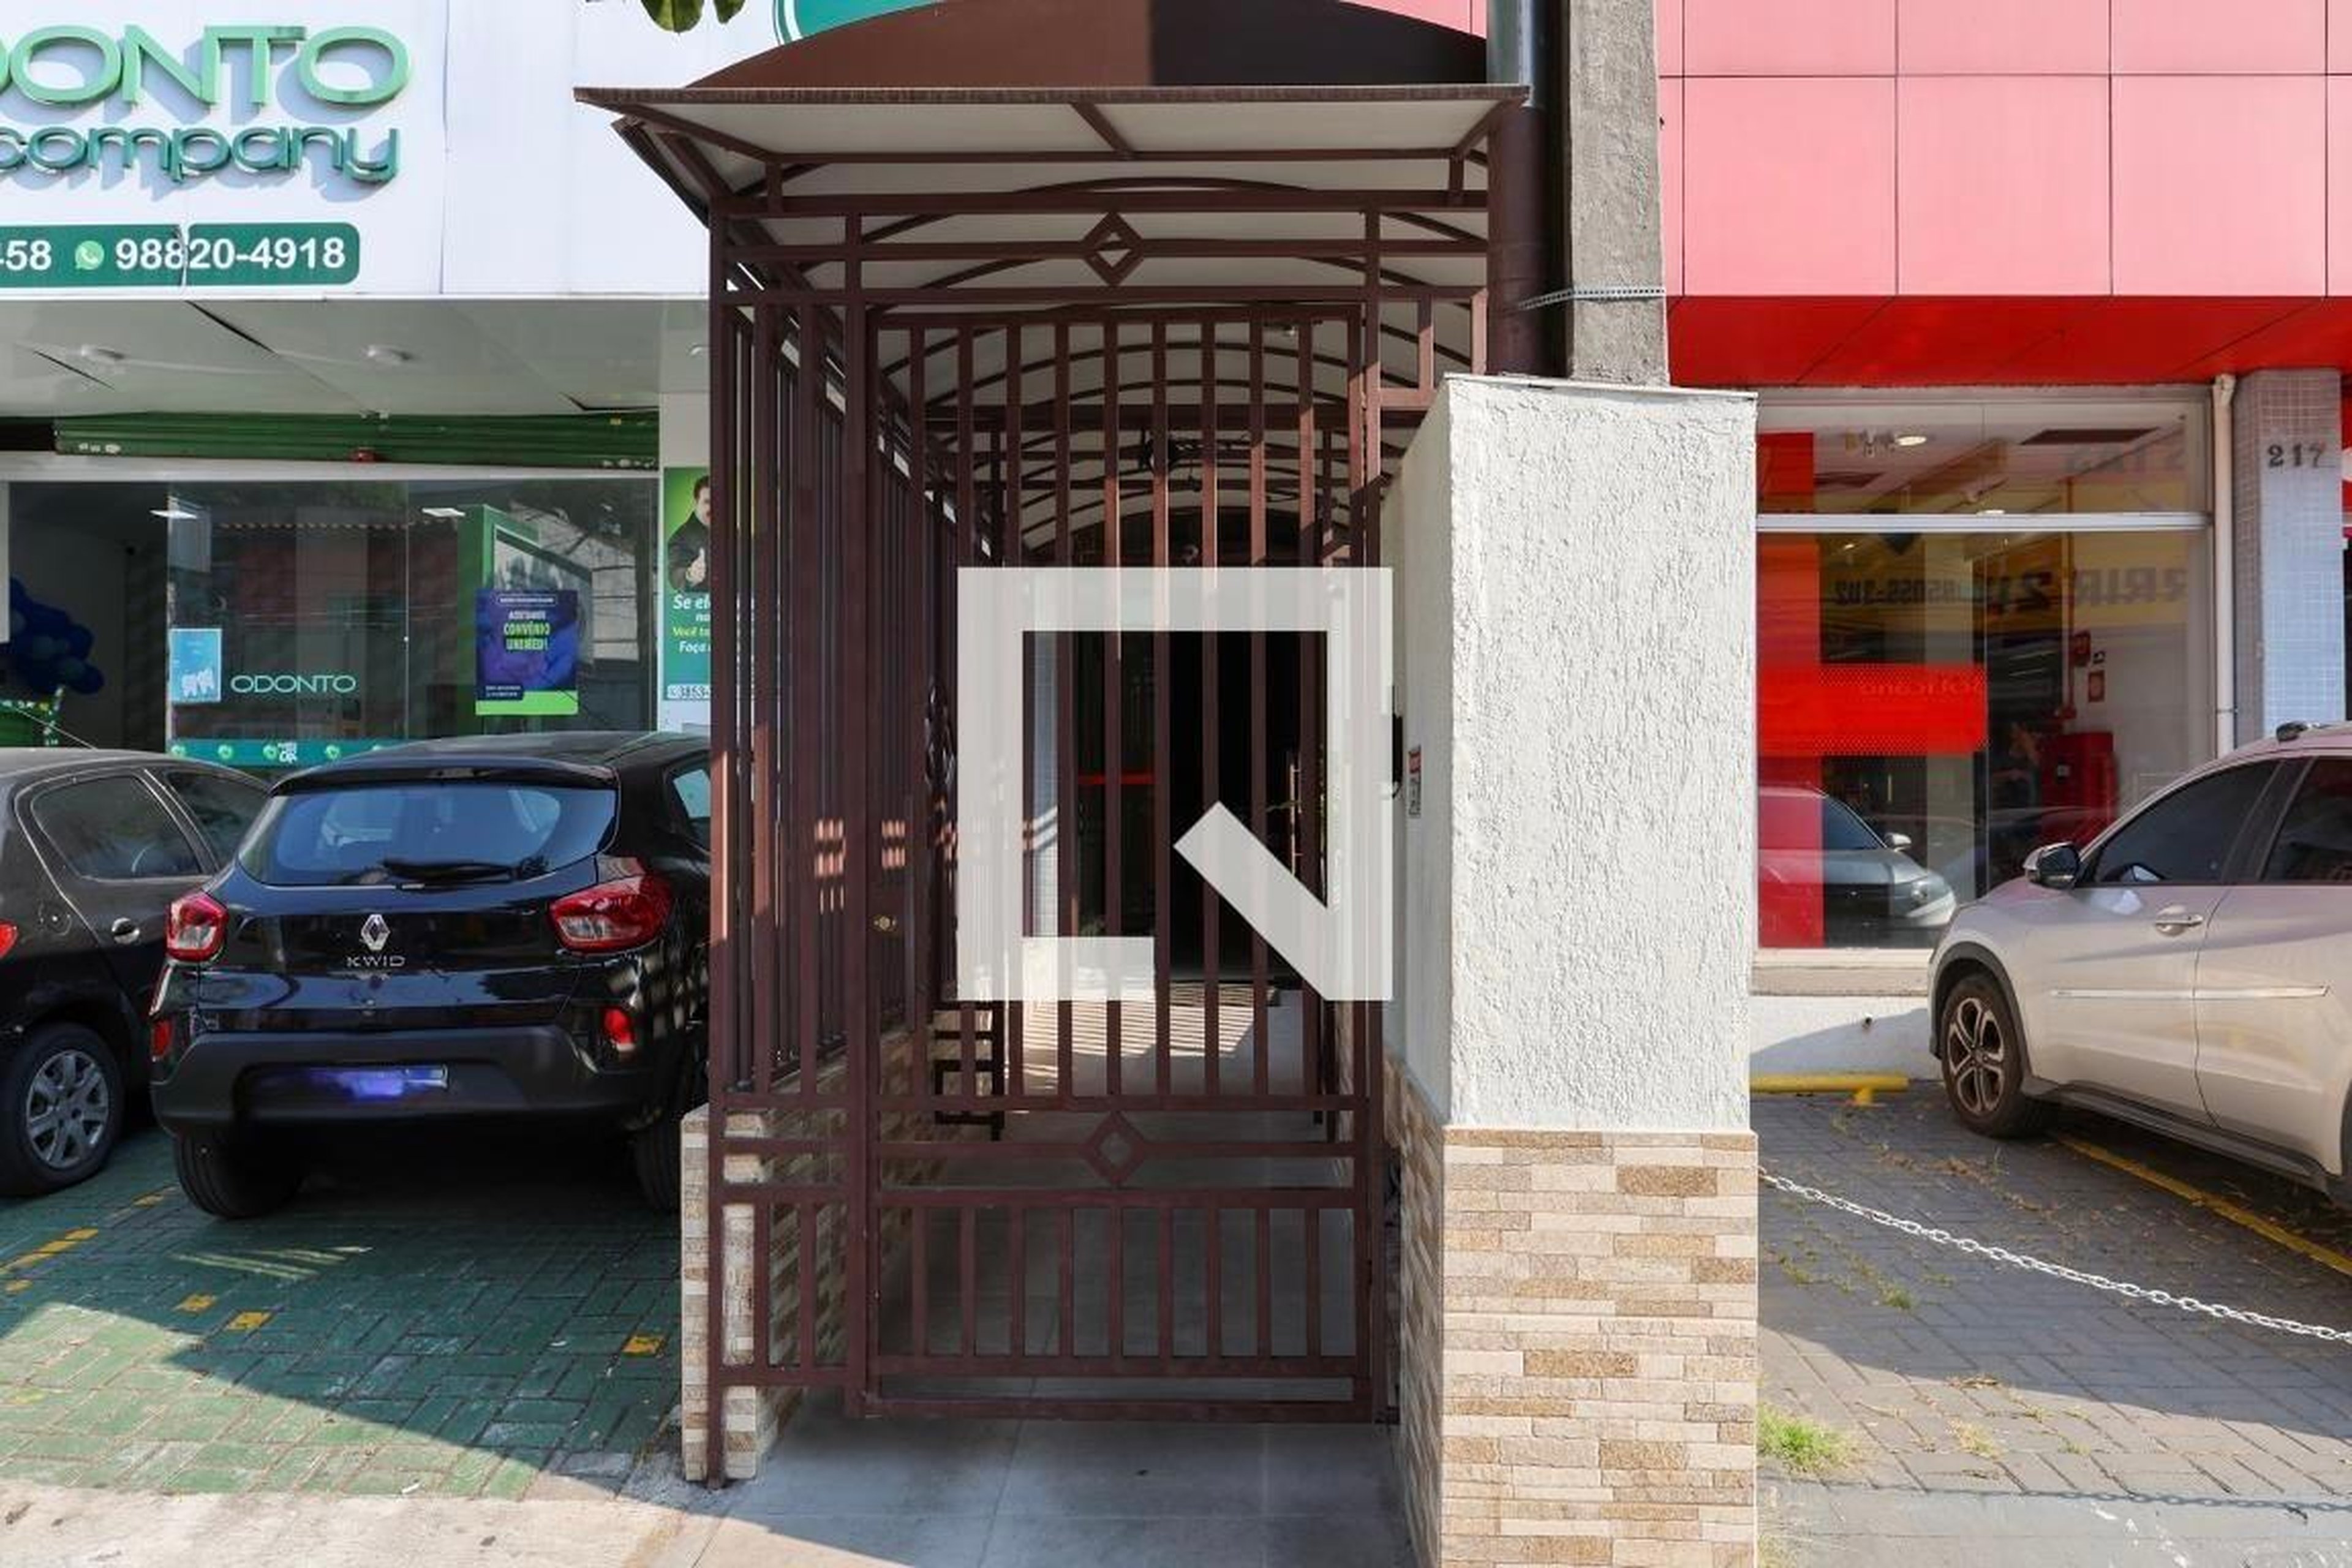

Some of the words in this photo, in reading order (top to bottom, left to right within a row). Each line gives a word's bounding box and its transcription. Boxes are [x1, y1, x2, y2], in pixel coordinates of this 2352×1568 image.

[0, 25, 410, 107] ONTO
[0, 239, 53, 271] 58
[115, 236, 346, 270] 98820-4918
[2267, 442, 2326, 468] 217
[673, 594, 692, 609] Se
[230, 674, 356, 693] ODONTO
[346, 955, 405, 967] KWID
